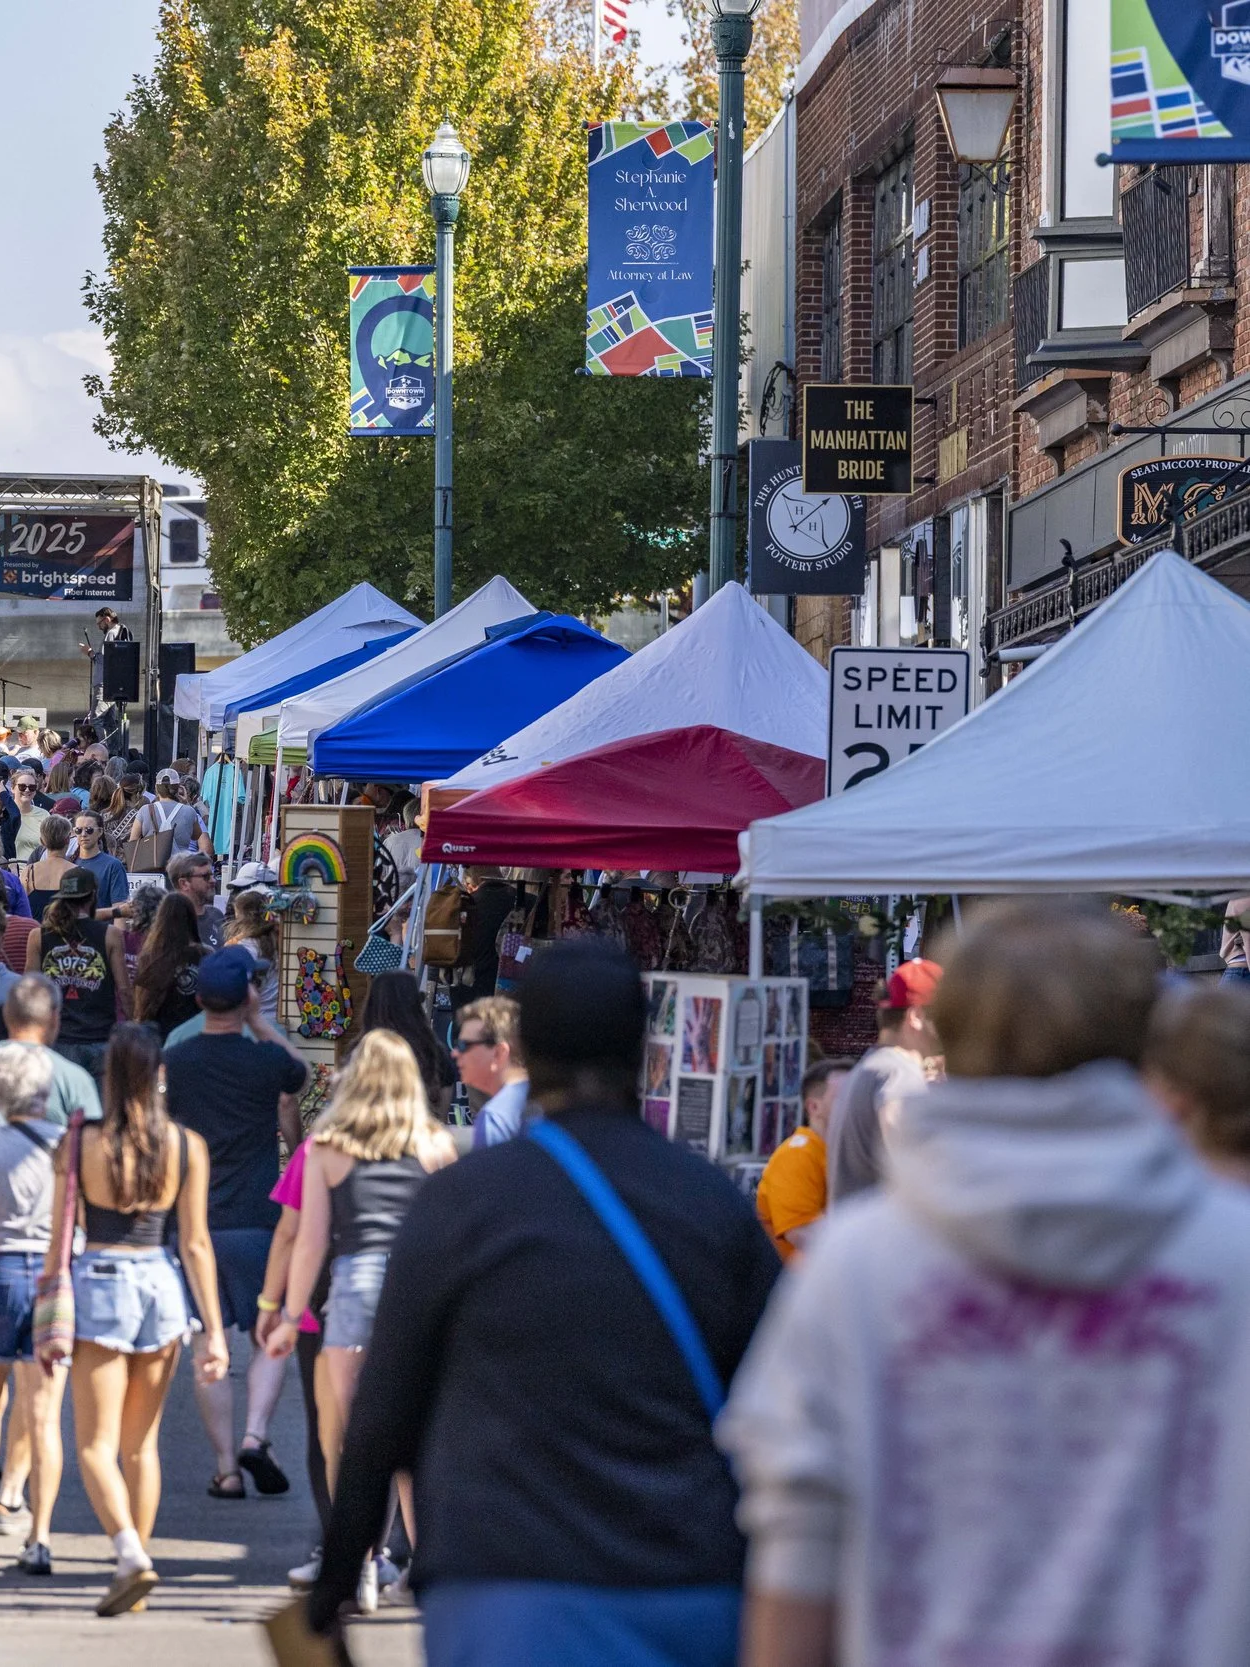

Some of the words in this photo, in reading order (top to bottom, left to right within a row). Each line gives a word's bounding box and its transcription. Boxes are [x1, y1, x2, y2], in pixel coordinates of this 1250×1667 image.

[615, 169, 687, 187] Stephanie
[645, 186, 657, 198] A.
[614, 197, 688, 212] Sherwood
[607, 269, 655, 283] Attorney
[657, 270, 668, 280] at
[671, 269, 695, 280] Law
[844, 399, 875, 421] THE
[810, 429, 907, 450] MANHATTAN
[837, 459, 885, 480] BRIDE
[1131, 464, 1159, 479] SEAN
[753, 484, 772, 507] THE
[769, 464, 803, 487] HUNT
[8, 521, 87, 556] 2025
[31, 561, 40, 569] by
[764, 542, 813, 572] POTTERY
[815, 541, 853, 571] STUDIO
[21, 570, 117, 588] brightspeed
[64, 588, 83, 596] Fiber
[84, 588, 116, 597] Internet
[842, 666, 958, 693] SPEED
[854, 703, 944, 731] LIMIT
[842, 742, 927, 791] 2
[442, 842, 477, 854] QUEST
[57, 956, 88, 972] 1975
